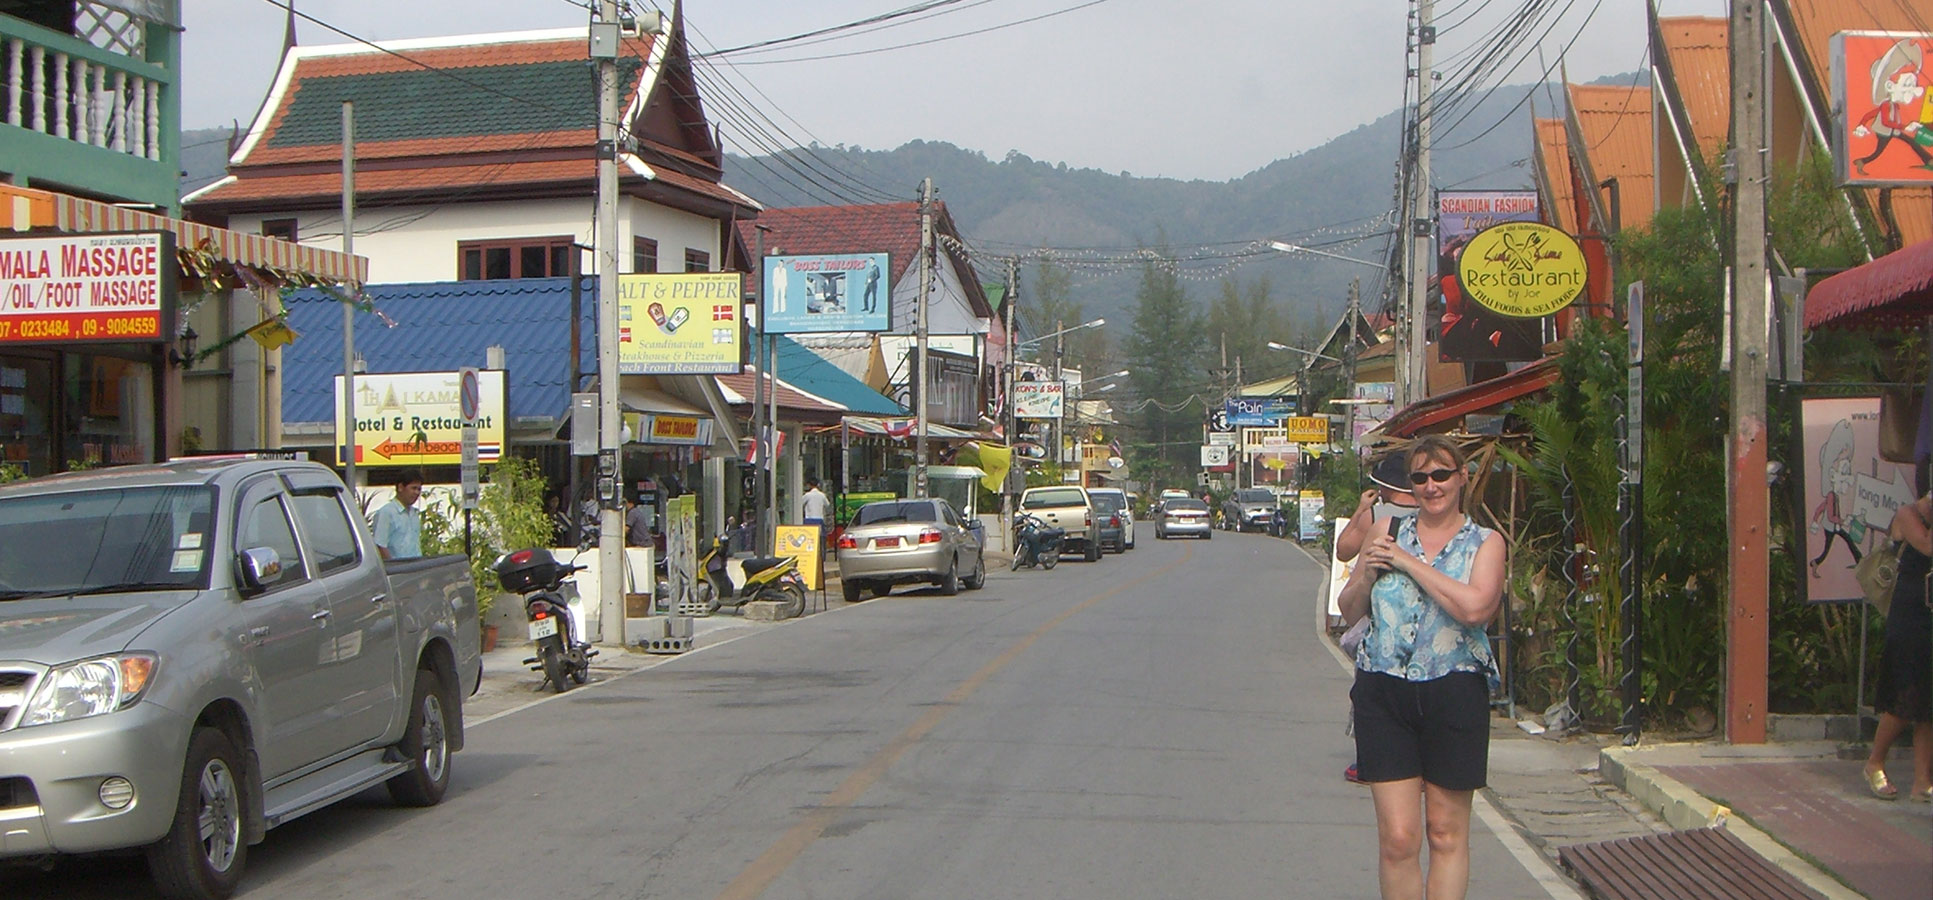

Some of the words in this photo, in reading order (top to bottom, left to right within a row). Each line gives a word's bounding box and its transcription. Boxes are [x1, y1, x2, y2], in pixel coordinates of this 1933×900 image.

[1441, 198, 1490, 213] SCANDIAN
[1494, 197, 1535, 213] FASHION
[1463, 215, 1511, 230] Tail
[61, 244, 157, 278] MASSAGE
[794, 260, 822, 271] BOSS
[824, 259, 867, 271] TAILORS
[1467, 268, 1580, 287] Restaurant
[90, 280, 156, 306] MASSAGE
[618, 282, 650, 299] ALT
[653, 282, 667, 299] &
[672, 281, 738, 299] PEPPER
[1474, 289, 1493, 307] THAI
[1494, 301, 1523, 315] FOODS
[1533, 302, 1551, 313] SEA
[1551, 287, 1576, 308] FOODS
[20, 319, 69, 336] 0233484
[82, 318, 97, 335] 09
[107, 317, 156, 335] 9084559
[639, 339, 704, 350] Scandinavian
[620, 352, 670, 361] teakhouse
[685, 350, 725, 361] Pizzeria
[642, 362, 671, 372] Front
[675, 362, 733, 373] Restaurant
[393, 417, 403, 430] &
[411, 415, 492, 430] Restaunt
[1291, 419, 1325, 429] UOMO
[383, 444, 396, 453] on
[427, 442, 461, 453] beach
